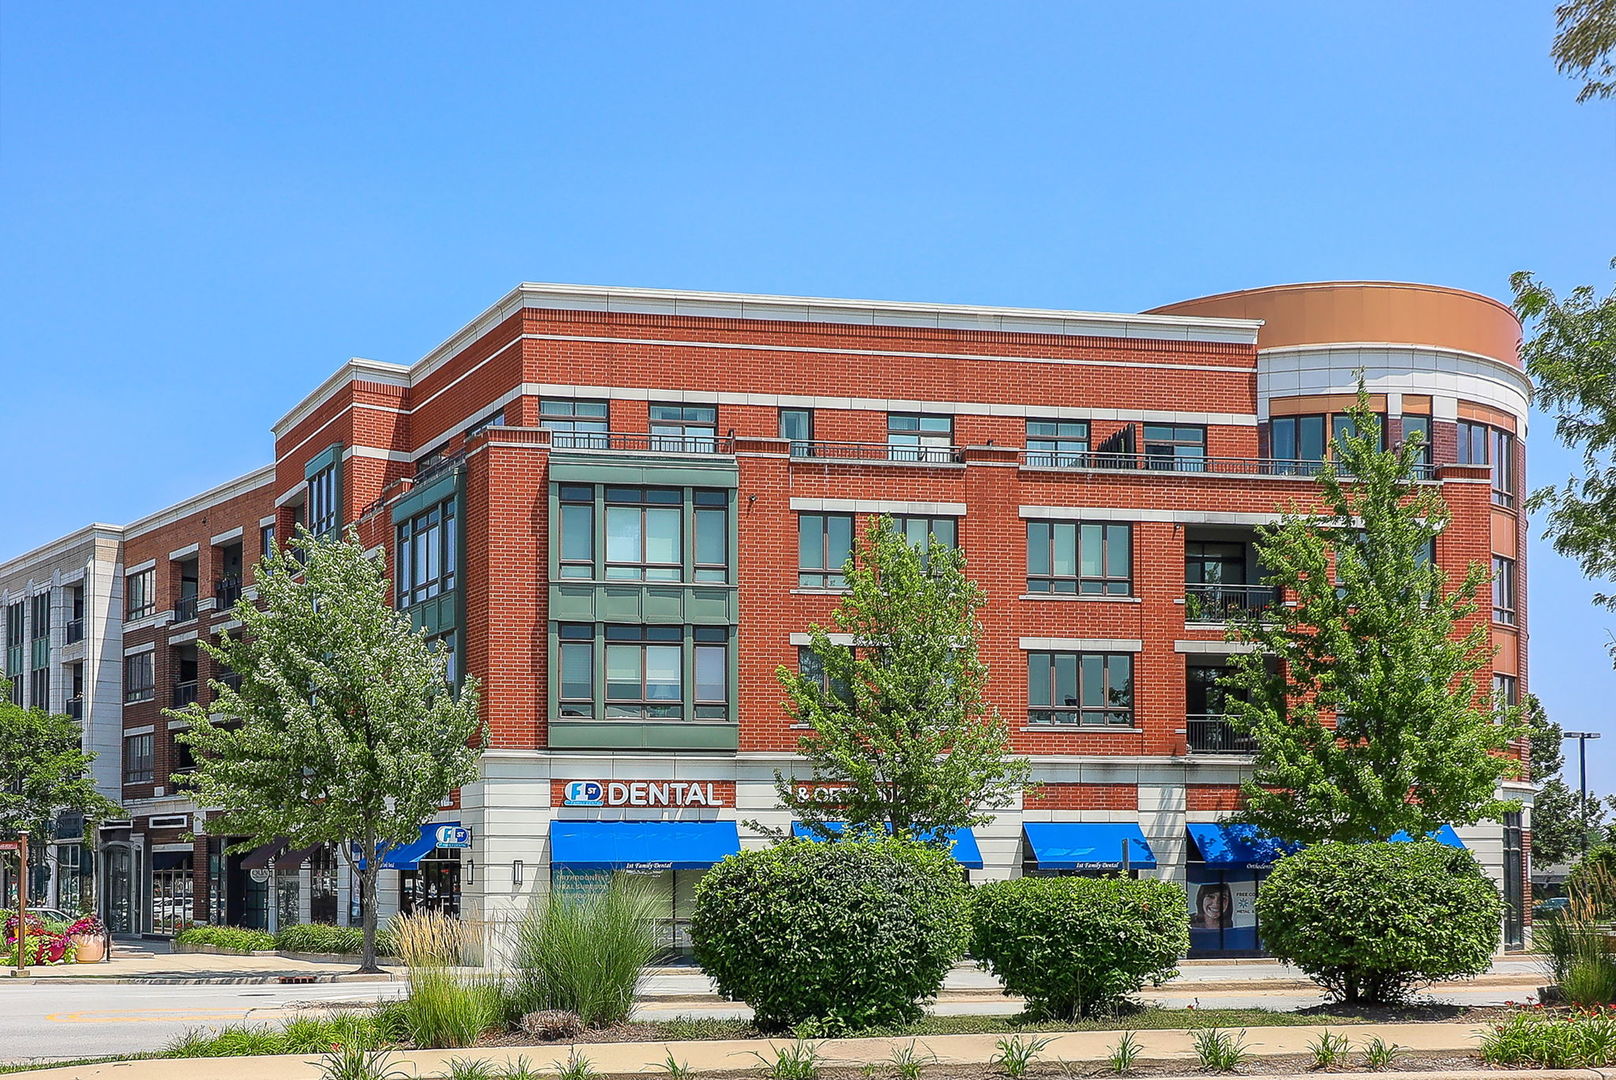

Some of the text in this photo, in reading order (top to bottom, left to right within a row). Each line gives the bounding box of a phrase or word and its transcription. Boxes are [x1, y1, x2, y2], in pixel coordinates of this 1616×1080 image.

[607, 781, 725, 807] DENTAL
[635, 862, 653, 870] Family
[1084, 862, 1101, 870] Family
